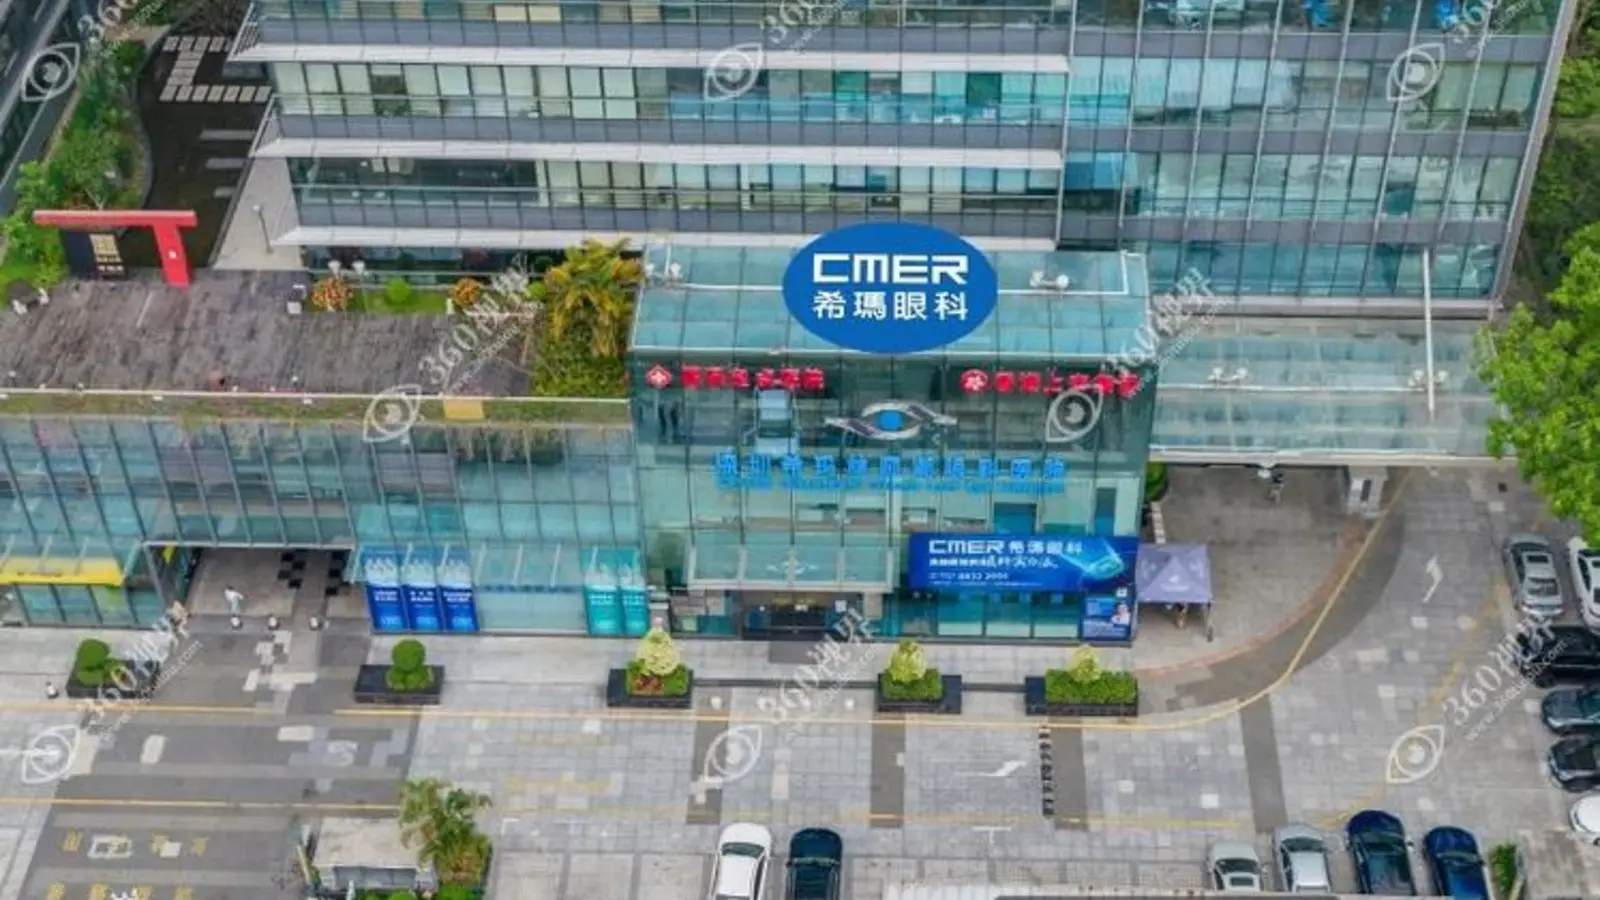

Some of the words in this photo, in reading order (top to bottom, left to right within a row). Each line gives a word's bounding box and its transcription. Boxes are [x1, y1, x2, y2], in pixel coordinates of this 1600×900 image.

[813, 253, 969, 284] CMER
[812, 290, 969, 320] 希瑪眼科
[929, 540, 1004, 554] CMER
